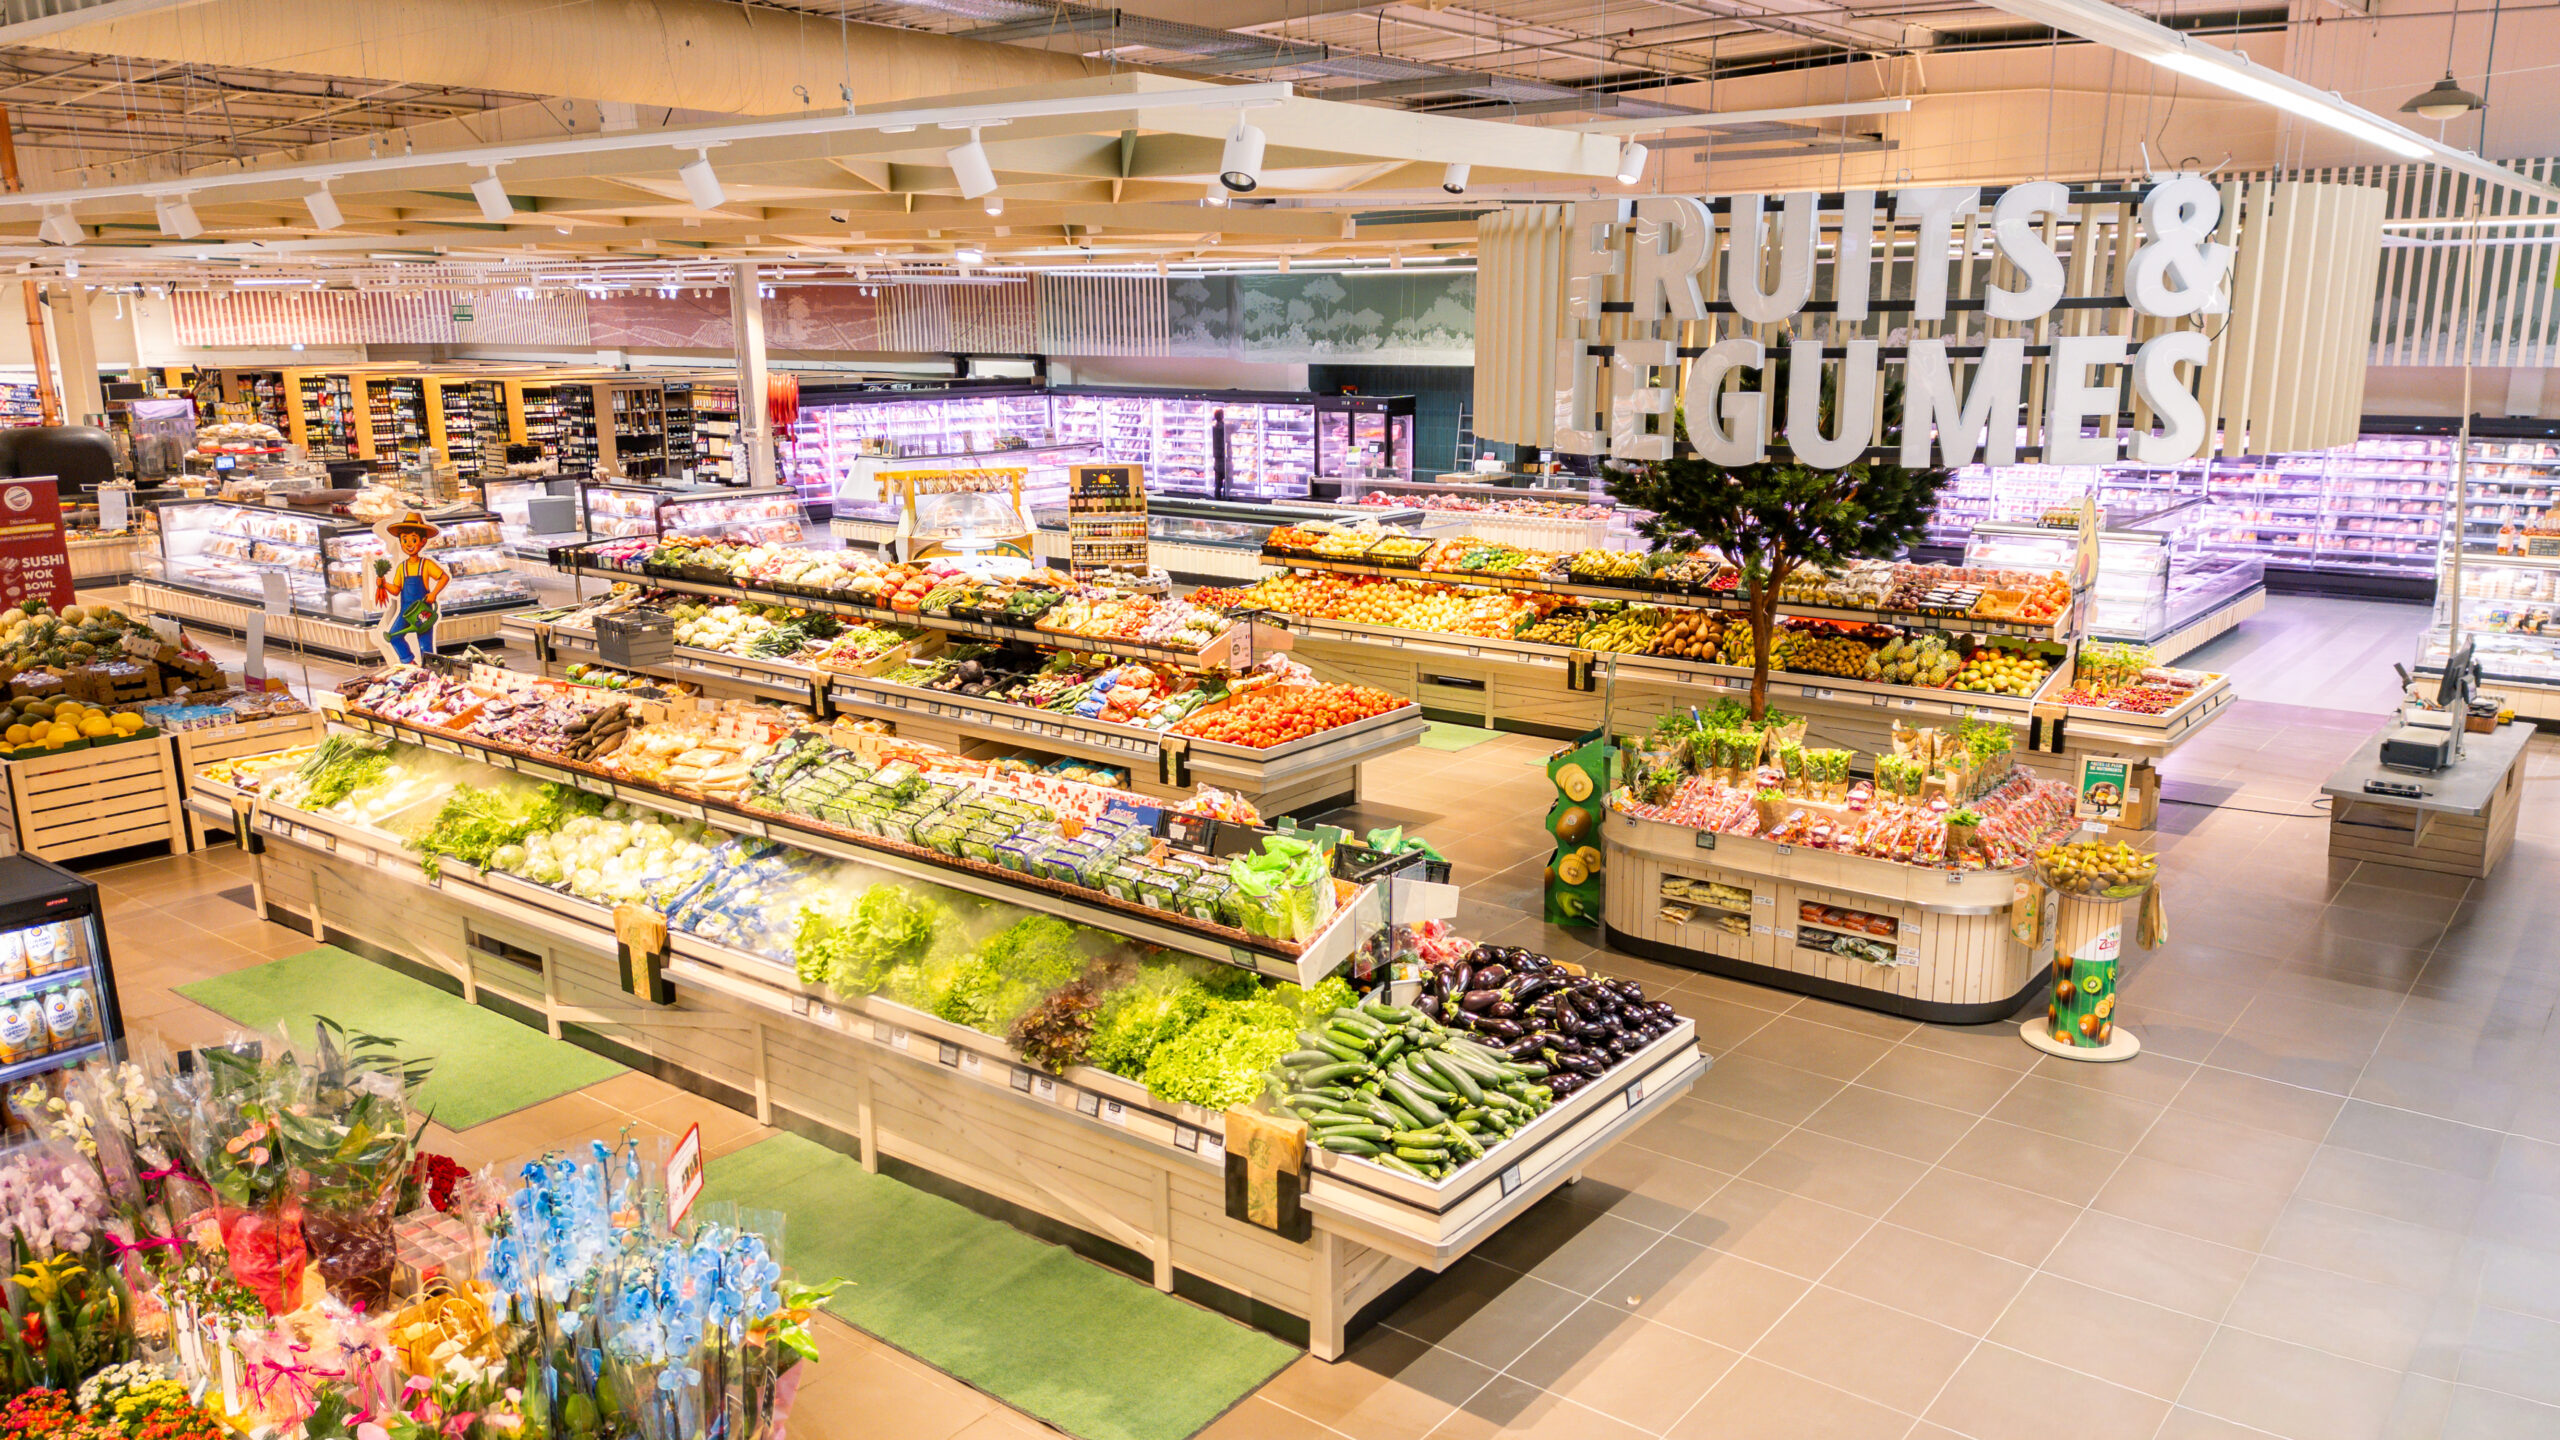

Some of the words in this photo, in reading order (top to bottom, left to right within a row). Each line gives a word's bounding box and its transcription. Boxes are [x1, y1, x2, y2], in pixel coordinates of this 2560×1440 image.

[1569, 181, 2071, 323] FRUITS
[2126, 177, 2231, 318] &
[1553, 330, 2211, 469] LEGUMES
[22, 554, 64, 569] SUSHI
[23, 568, 54, 581] WOK
[24, 580, 56, 591] BOWL
